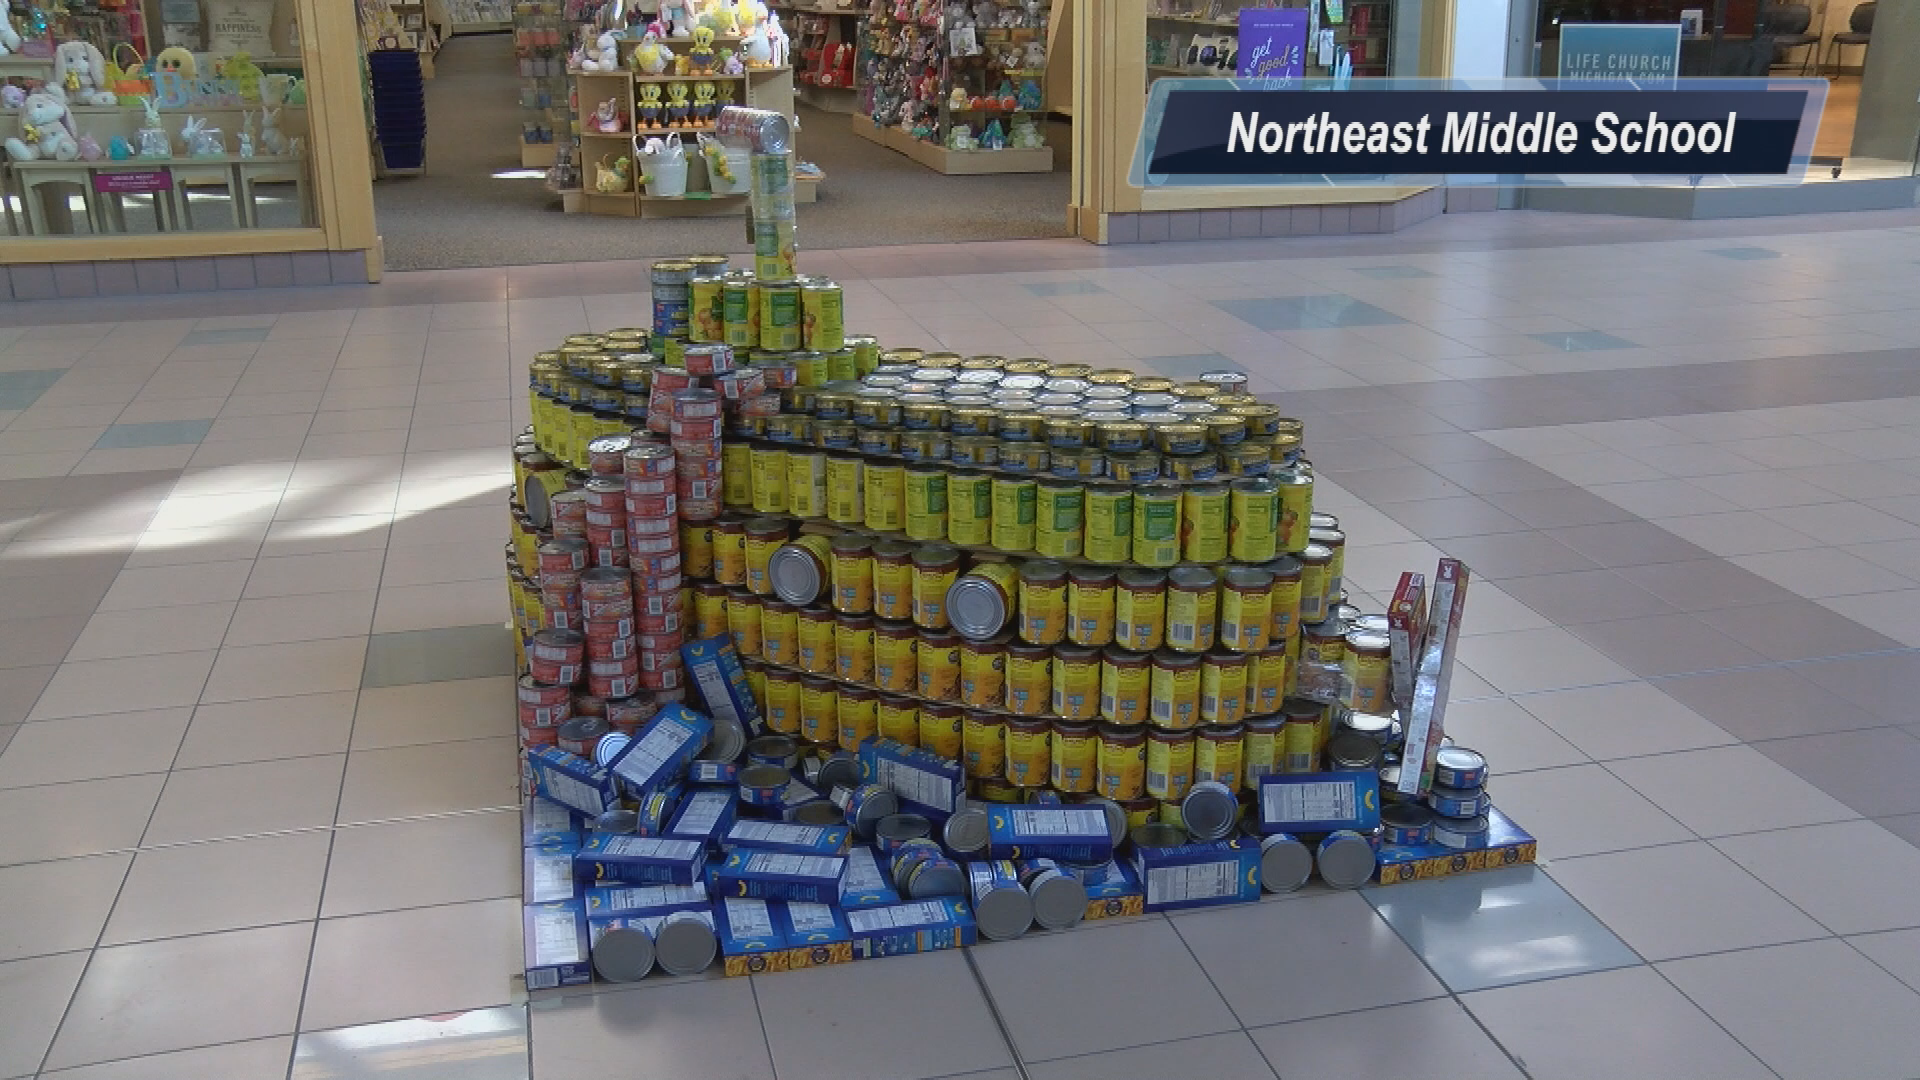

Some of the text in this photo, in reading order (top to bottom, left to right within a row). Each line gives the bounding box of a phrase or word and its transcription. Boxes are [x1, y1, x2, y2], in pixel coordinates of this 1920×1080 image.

[1250, 36, 1272, 68] get
[1257, 44, 1290, 82] good
[1567, 53, 1671, 70] LIFE CHURCH
